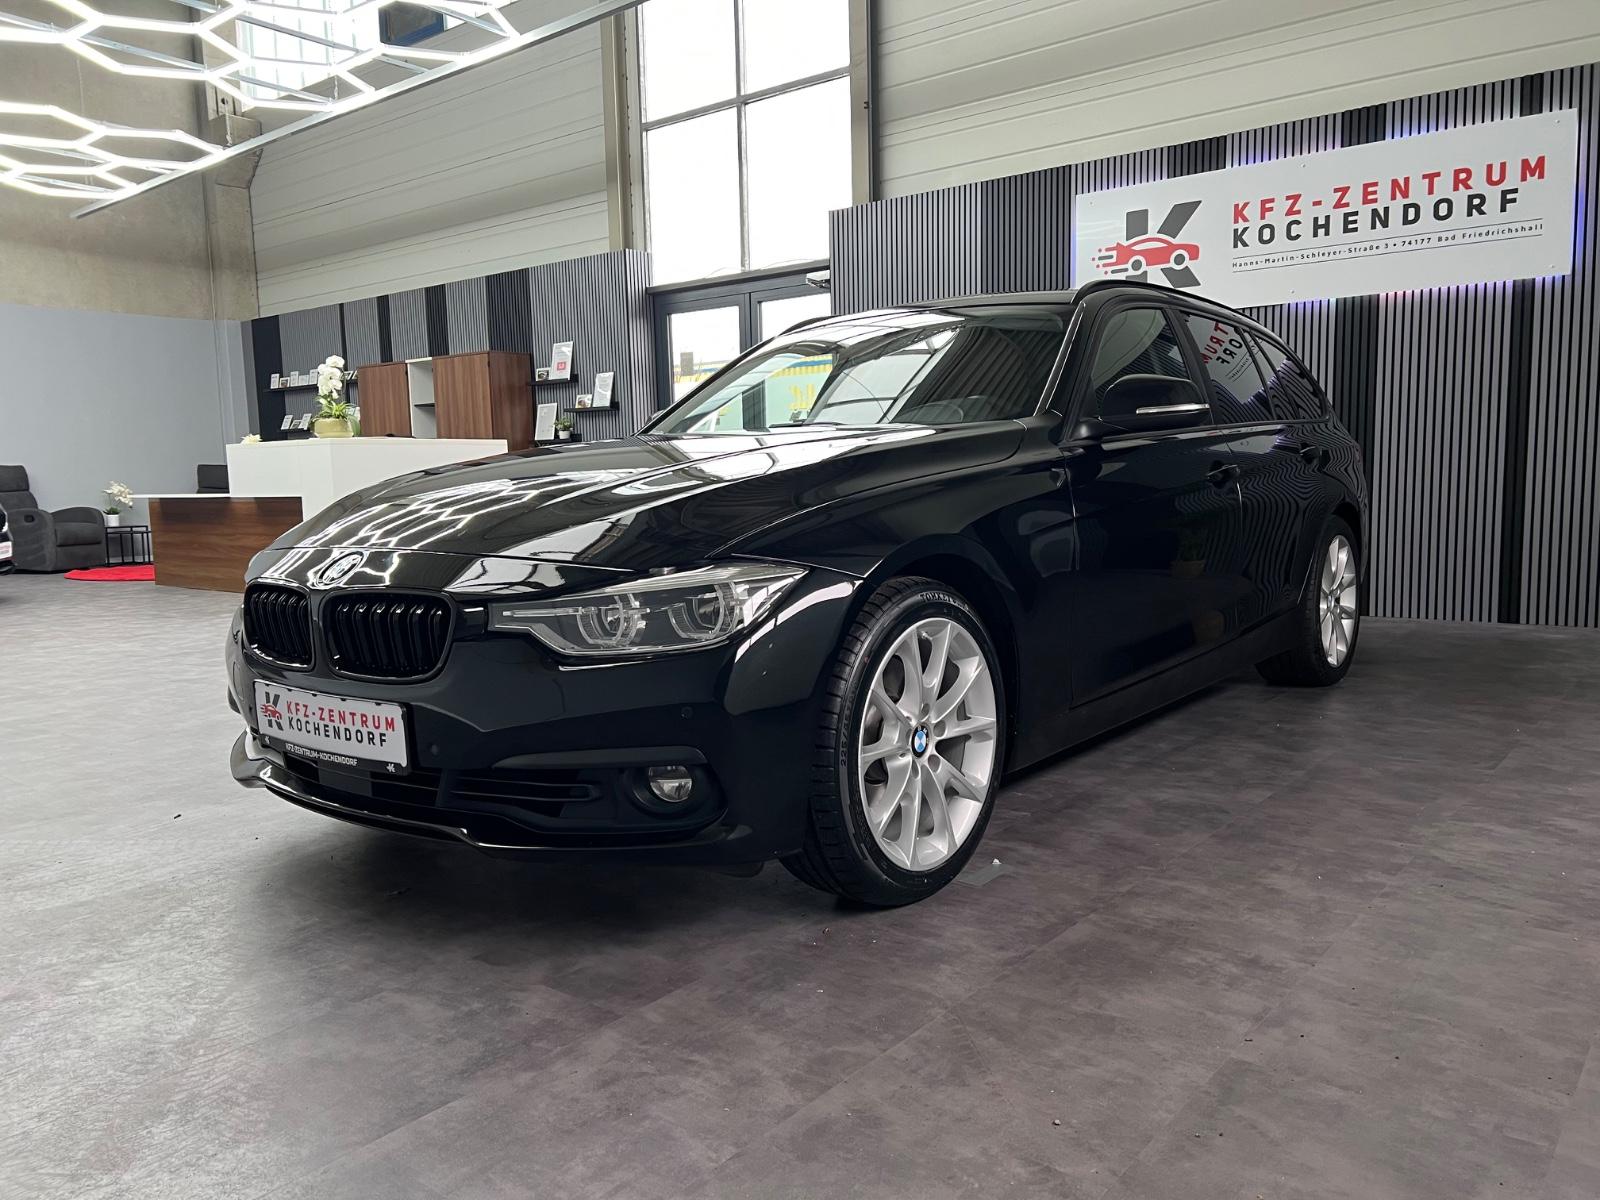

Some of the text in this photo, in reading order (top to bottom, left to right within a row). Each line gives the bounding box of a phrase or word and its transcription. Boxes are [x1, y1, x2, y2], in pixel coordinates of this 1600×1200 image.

[1233, 155, 1547, 224] KFZ-ZENTRUM
[1233, 187, 1520, 249] KOCHENDORF
[1401, 238, 1432, 247] 74177
[1437, 234, 1456, 243] Bad
[1462, 223, 1543, 240] Friedrichshall
[286, 700, 396, 732] KFZ-ZENTRUM
[287, 716, 388, 748] KOCHENDORF
[285, 742, 359, 767] KFZ-ZENTRUM-KOCHENDORF
